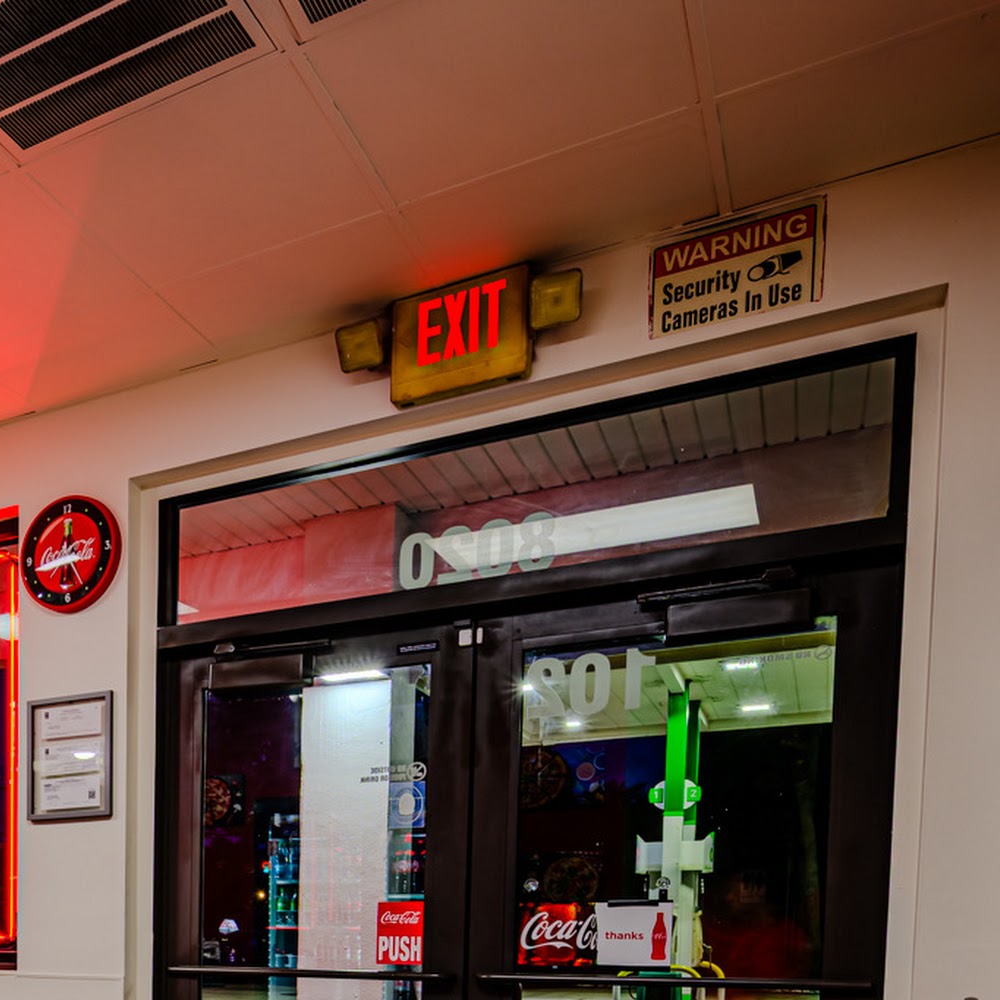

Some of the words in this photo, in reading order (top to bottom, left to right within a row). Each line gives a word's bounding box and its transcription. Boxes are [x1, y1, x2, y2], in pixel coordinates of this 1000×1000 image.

[662, 214, 807, 272] WARNING
[662, 269, 741, 306] Security
[661, 299, 739, 333] Cameras
[744, 290, 762, 313] In
[768, 283, 802, 307] Use
[416, 278, 507, 367] EXIT
[63, 503, 72, 514] 12
[104, 539, 111, 550] 3
[26, 557, 33, 567] 9
[64, 593, 71, 603] 6
[653, 790, 659, 799] 1
[690, 789, 698, 798] 2
[380, 910, 421, 925] Coca-Cola
[605, 931, 644, 940] thanks
[378, 935, 422, 962] PUSH
